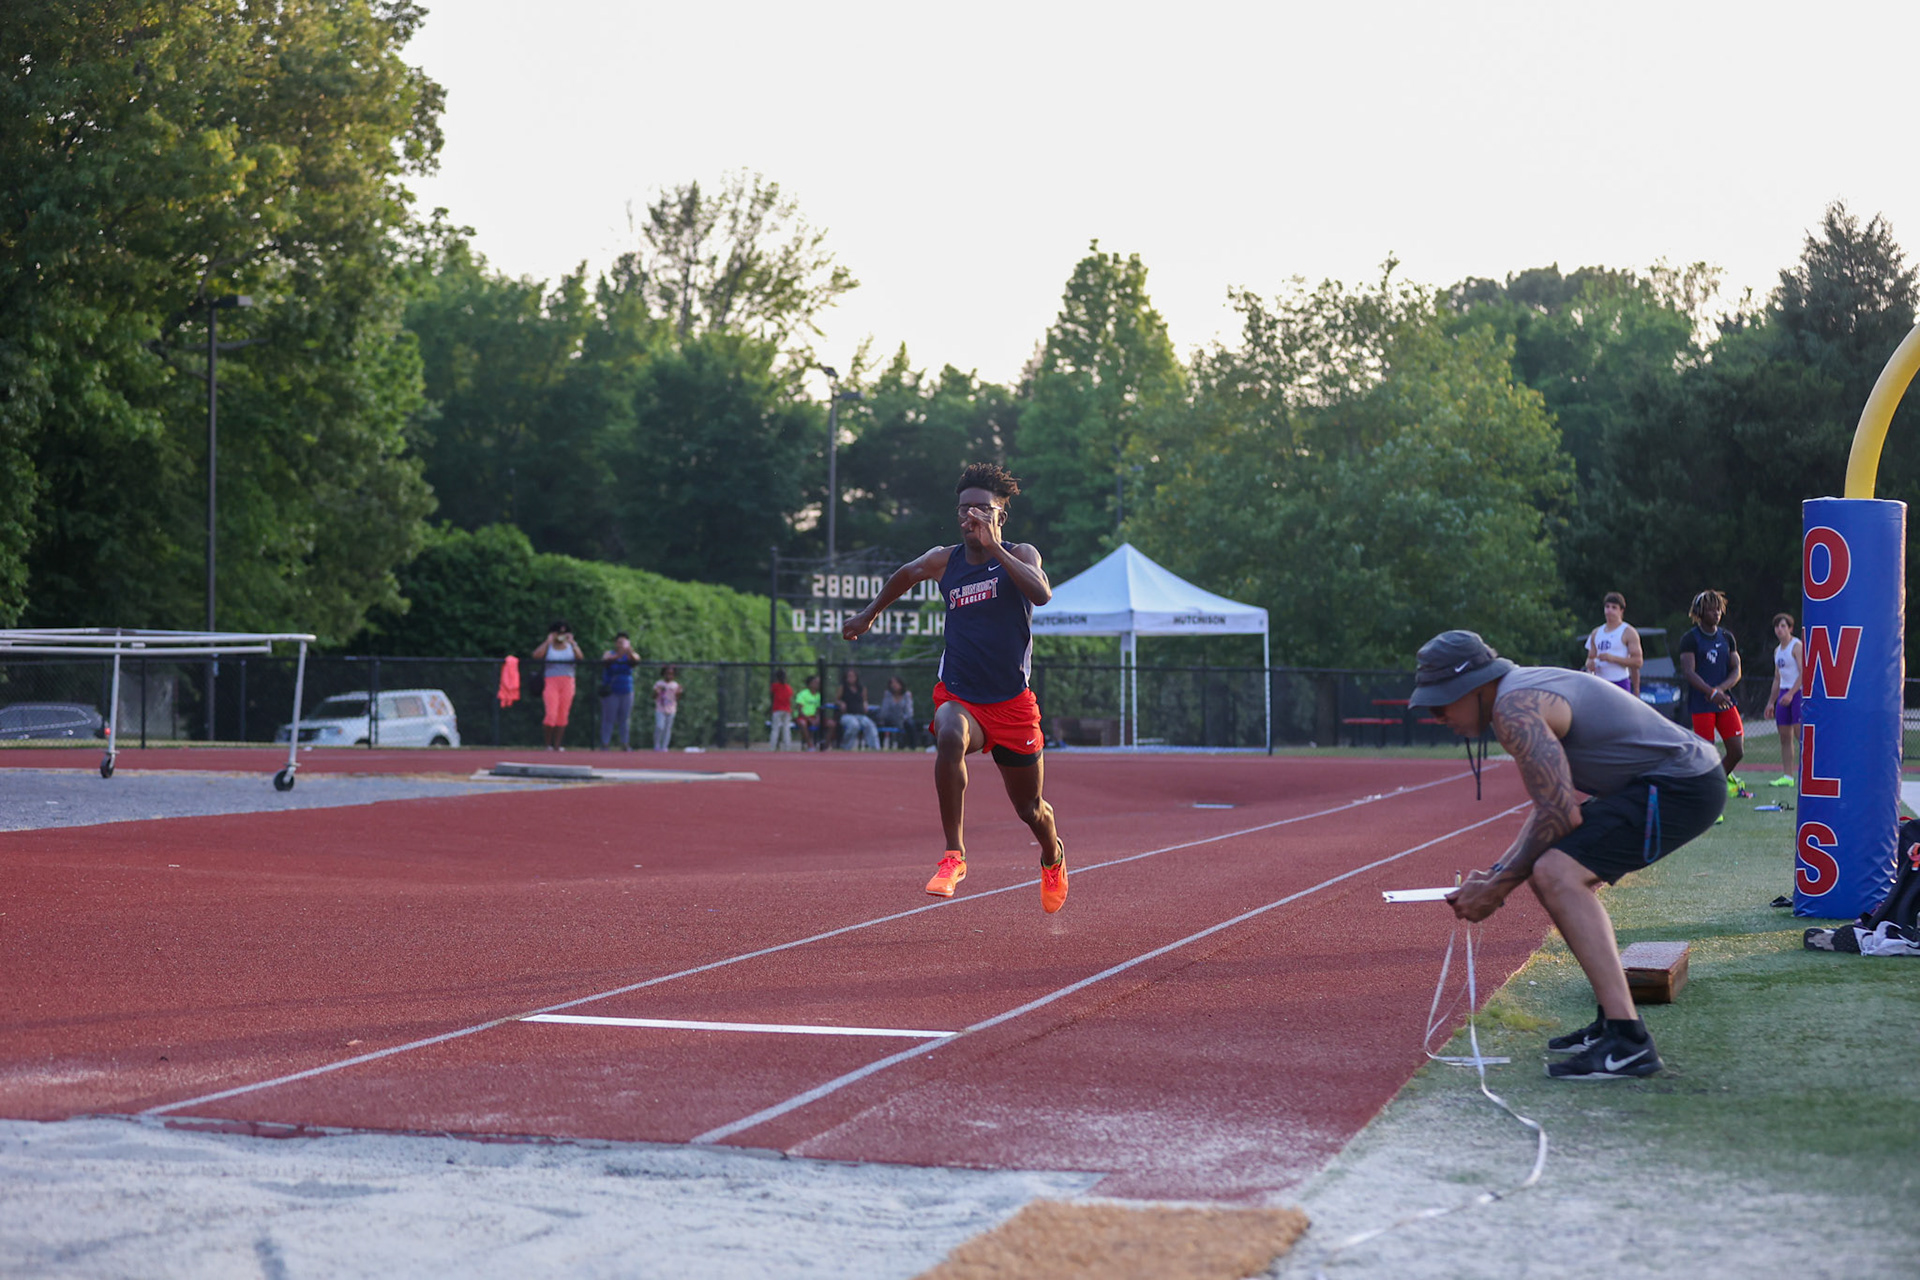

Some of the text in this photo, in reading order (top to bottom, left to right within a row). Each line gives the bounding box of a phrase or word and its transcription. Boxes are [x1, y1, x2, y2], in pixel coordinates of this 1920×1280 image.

[960, 592, 987, 606] EAGLES
[1173, 615, 1226, 625] HUTCHISON
[1796, 526, 1864, 898] OWLS
